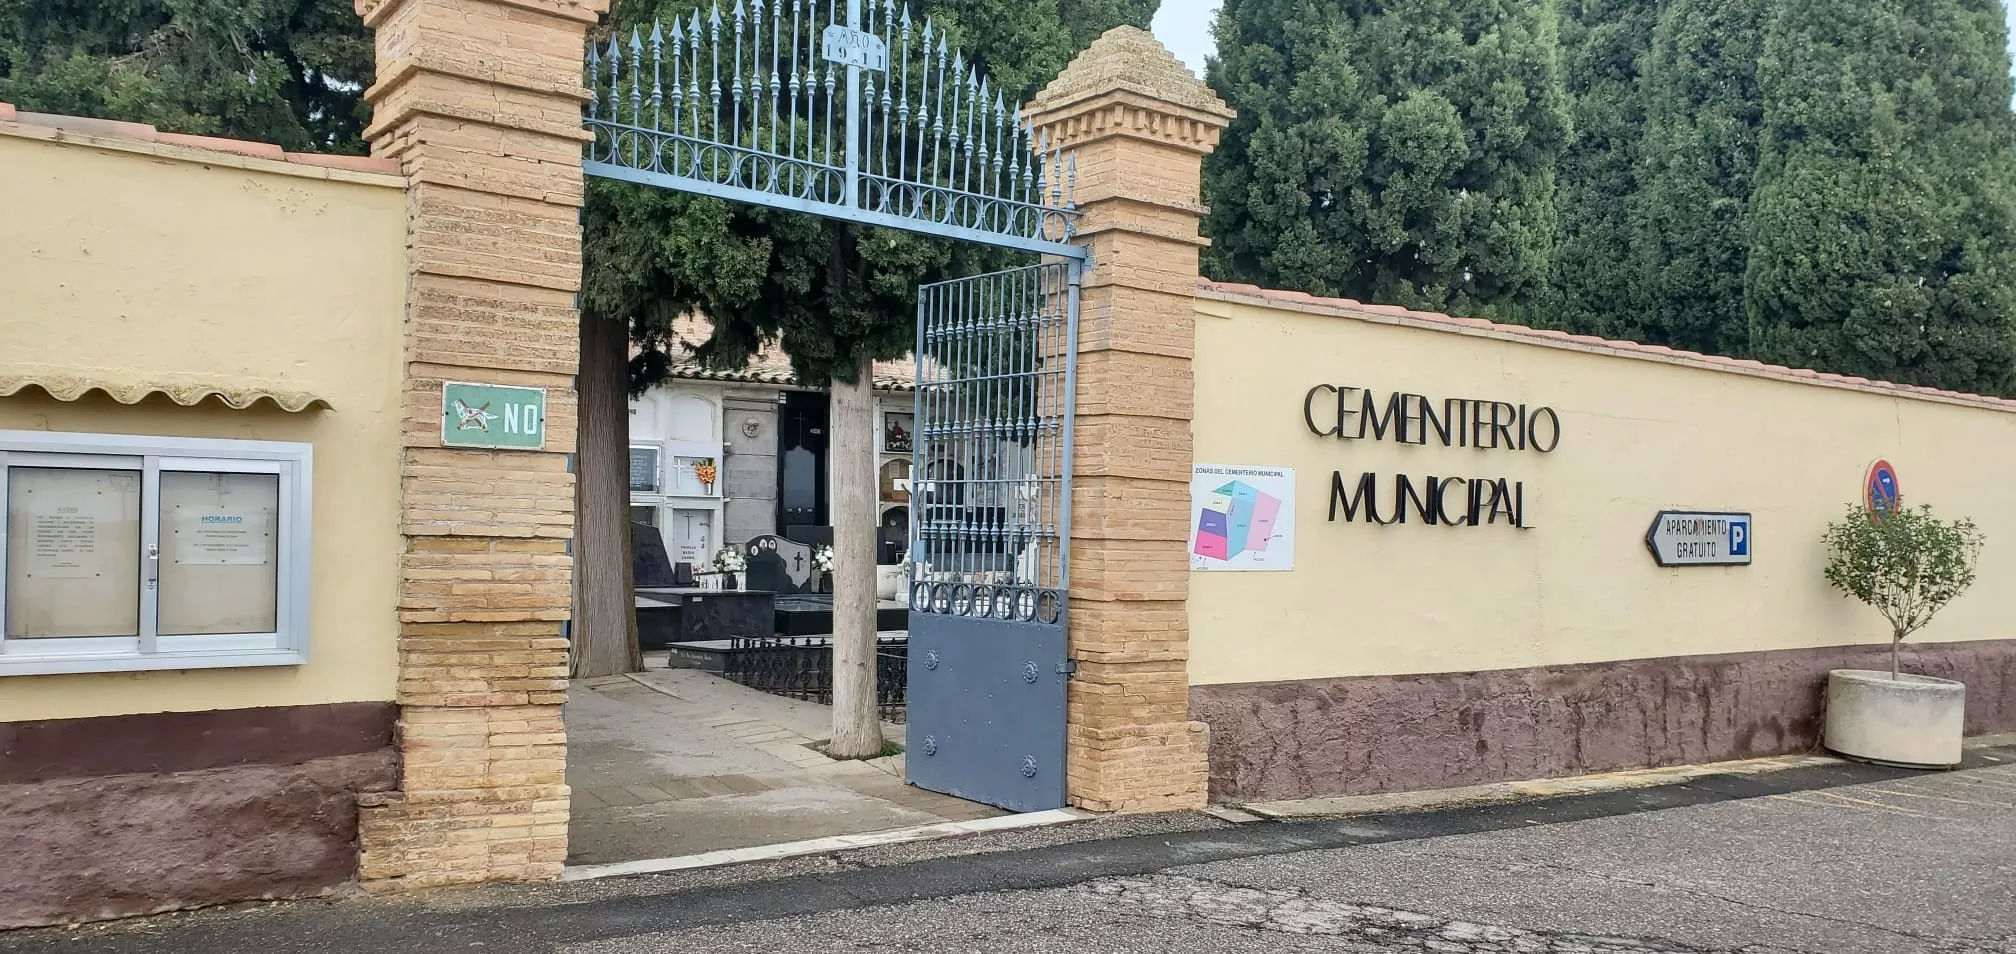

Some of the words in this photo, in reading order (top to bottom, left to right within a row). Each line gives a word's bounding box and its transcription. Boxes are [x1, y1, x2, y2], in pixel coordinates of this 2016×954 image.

[504, 402, 537, 435] NO
[1304, 384, 1560, 452] CEMENTERIO
[1225, 468, 1257, 477] CEMENTERIO
[1328, 471, 1536, 529] MUNICIPAL
[201, 515, 242, 523] HORARIO
[1676, 541, 1716, 558] GRATUITO
